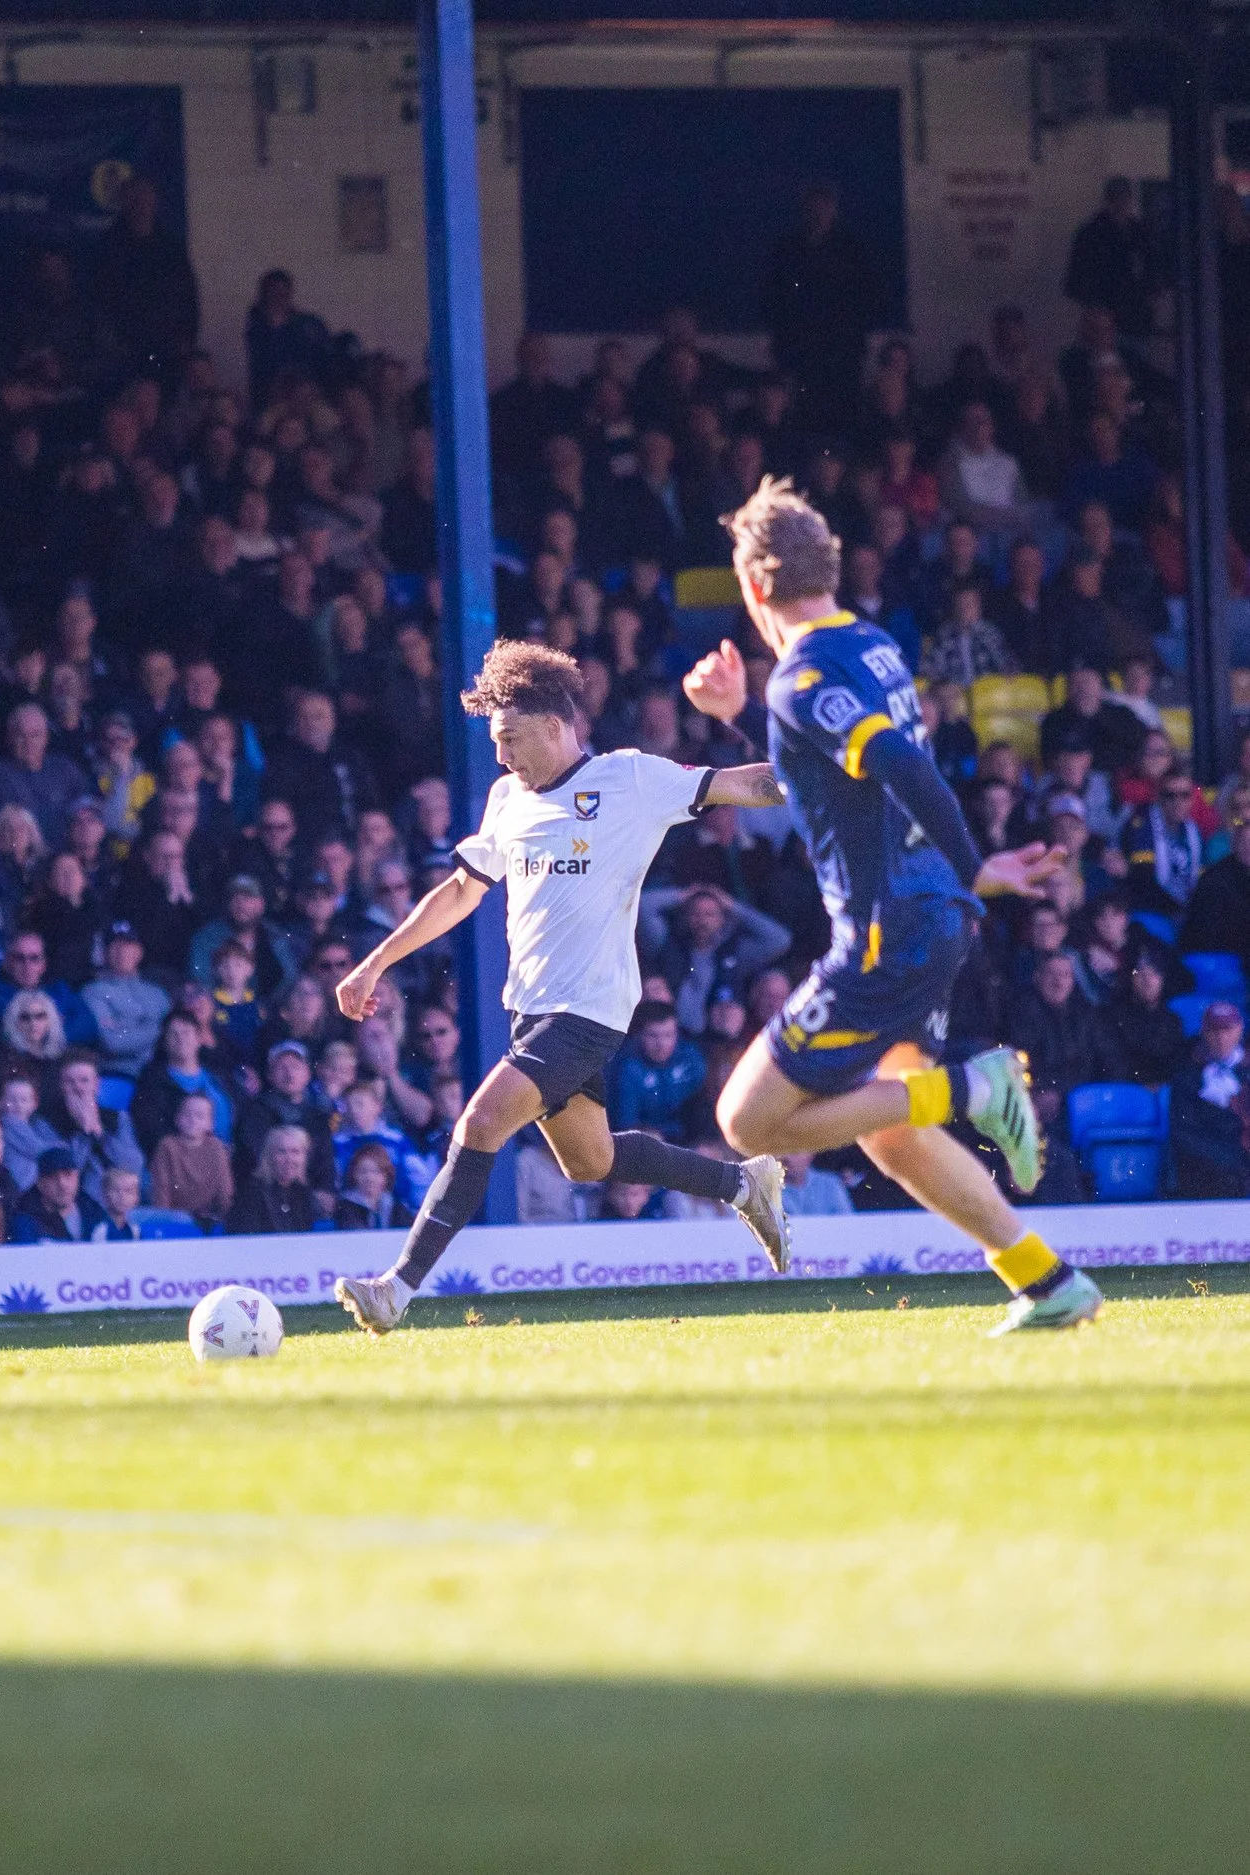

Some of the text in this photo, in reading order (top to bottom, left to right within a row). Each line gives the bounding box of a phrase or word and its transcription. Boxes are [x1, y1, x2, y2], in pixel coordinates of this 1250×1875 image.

[491, 1262, 564, 1287] Good
[573, 1261, 739, 1286] Governance
[57, 1276, 131, 1303] Good
